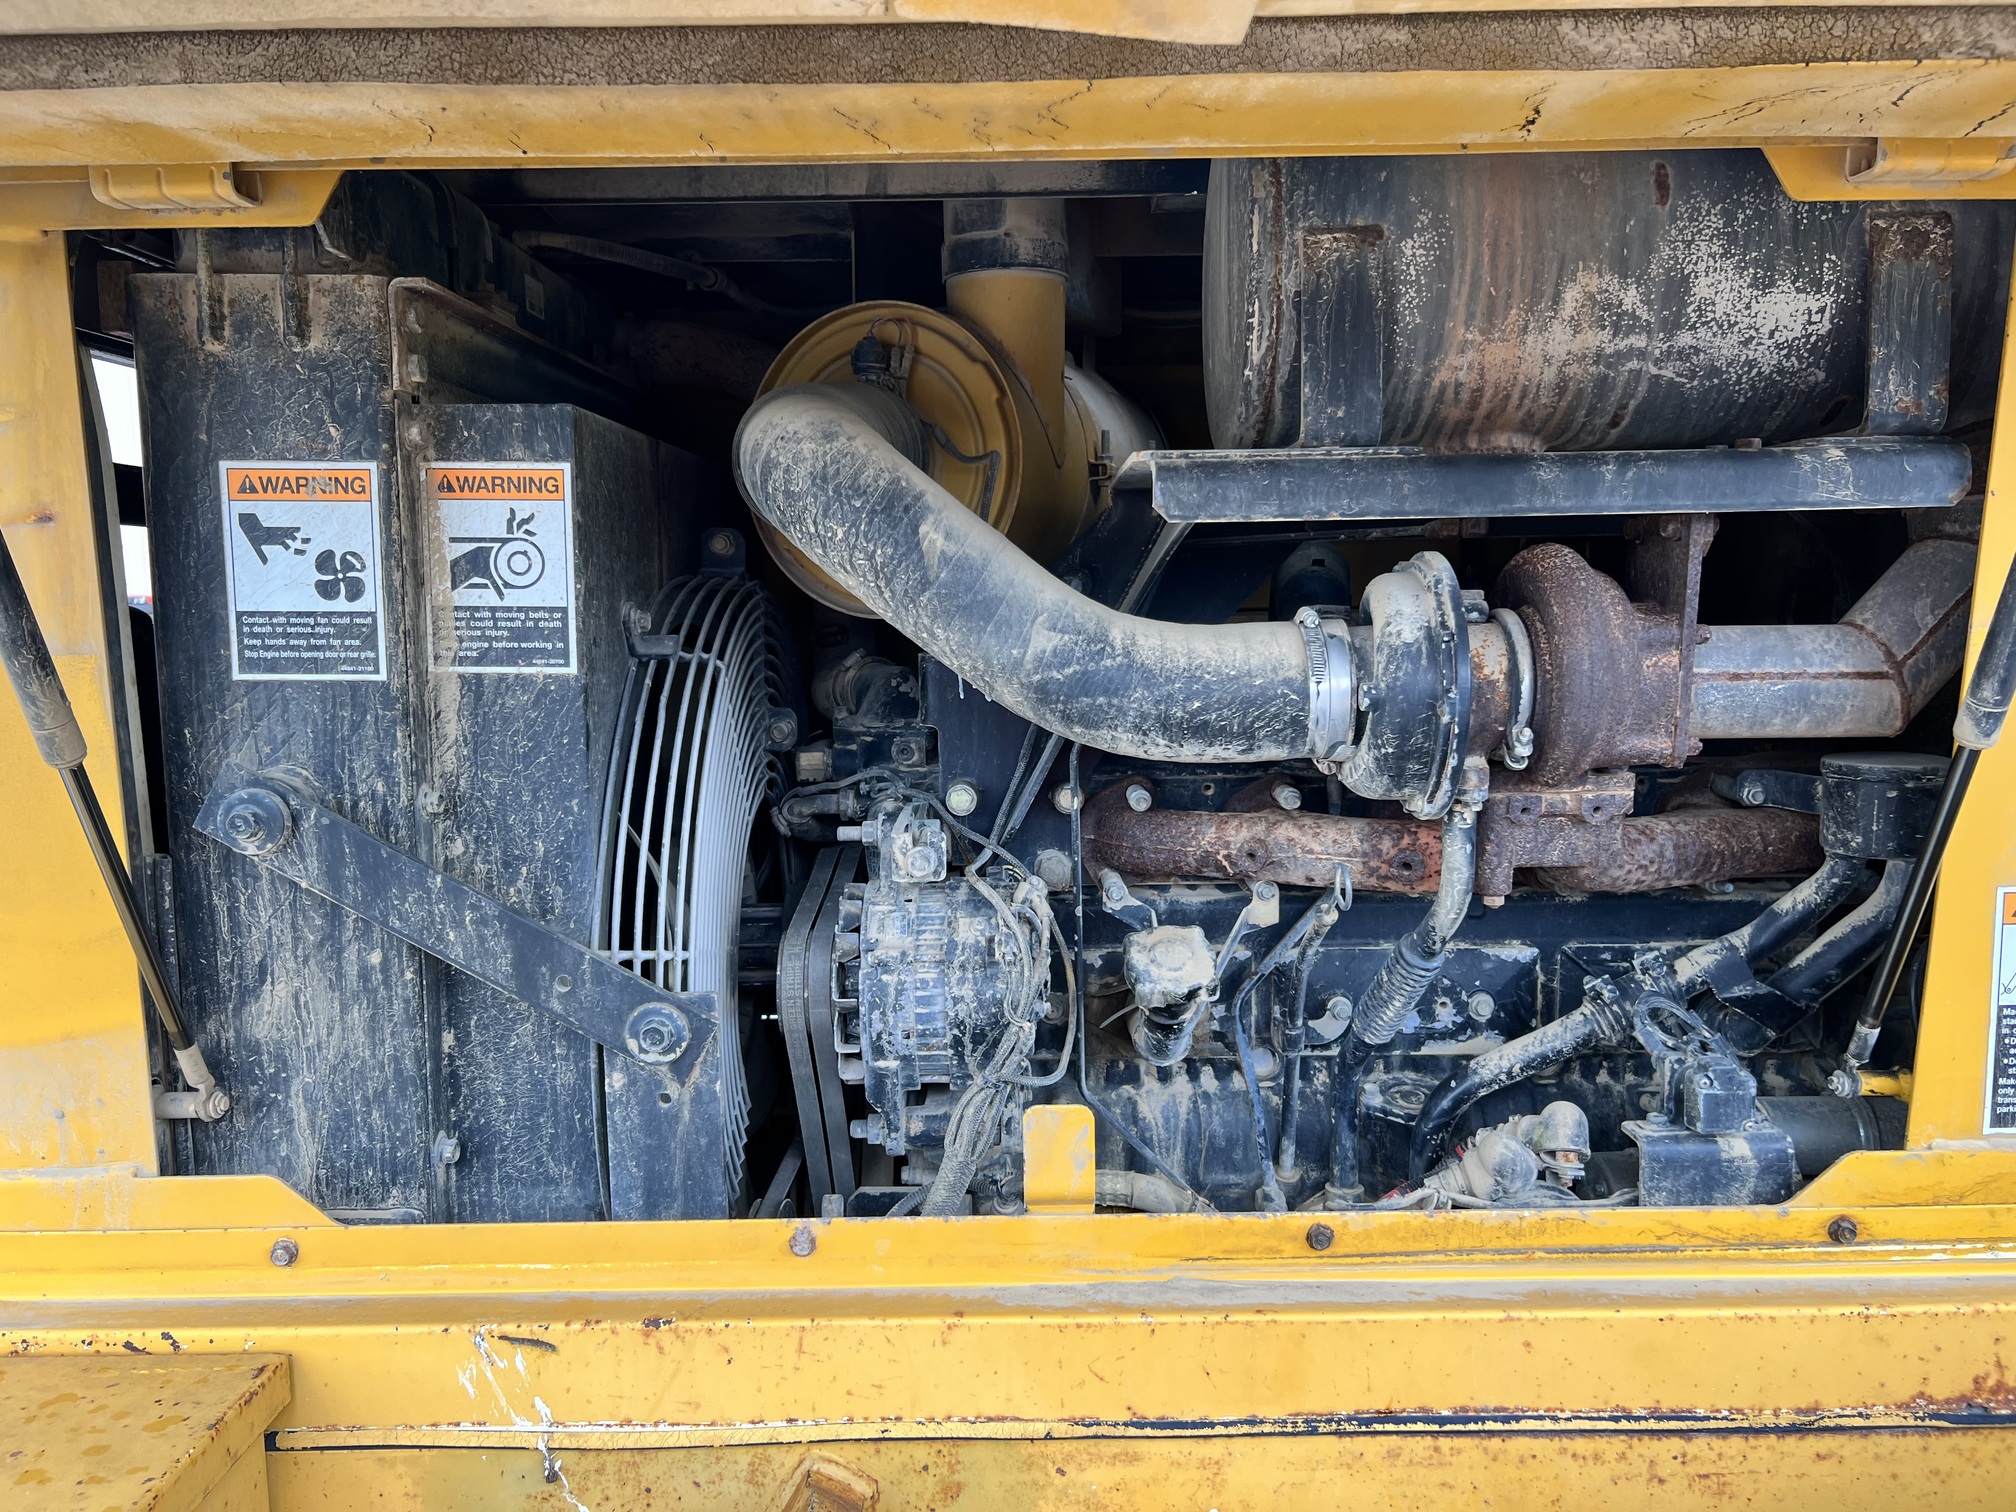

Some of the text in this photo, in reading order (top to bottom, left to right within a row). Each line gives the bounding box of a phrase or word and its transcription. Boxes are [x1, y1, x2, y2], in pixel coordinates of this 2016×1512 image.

[258, 476, 366, 495] WARNING
[456, 475, 559, 494] WARNING
[243, 615, 372, 625] Contact with moving fan could result
[496, 611, 525, 620] moving
[529, 611, 548, 619] belts
[538, 620, 562, 628] death
[315, 626, 336, 635] injury.
[485, 629, 510, 638] injury.
[244, 638, 261, 647] Keep
[265, 638, 286, 646] hands
[289, 639, 307, 647] away
[310, 638, 326, 646] from
[330, 638, 341, 646] fan
[462, 641, 489, 650] engine
[521, 641, 553, 650] working
[244, 650, 258, 659] Stop
[259, 650, 280, 659] Engine
[281, 650, 299, 658] before
[300, 651, 324, 659] opening
[325, 650, 338, 658] door
[786, 960, 795, 997] STRIPE
[1998, 1086, 2015, 1095] only
